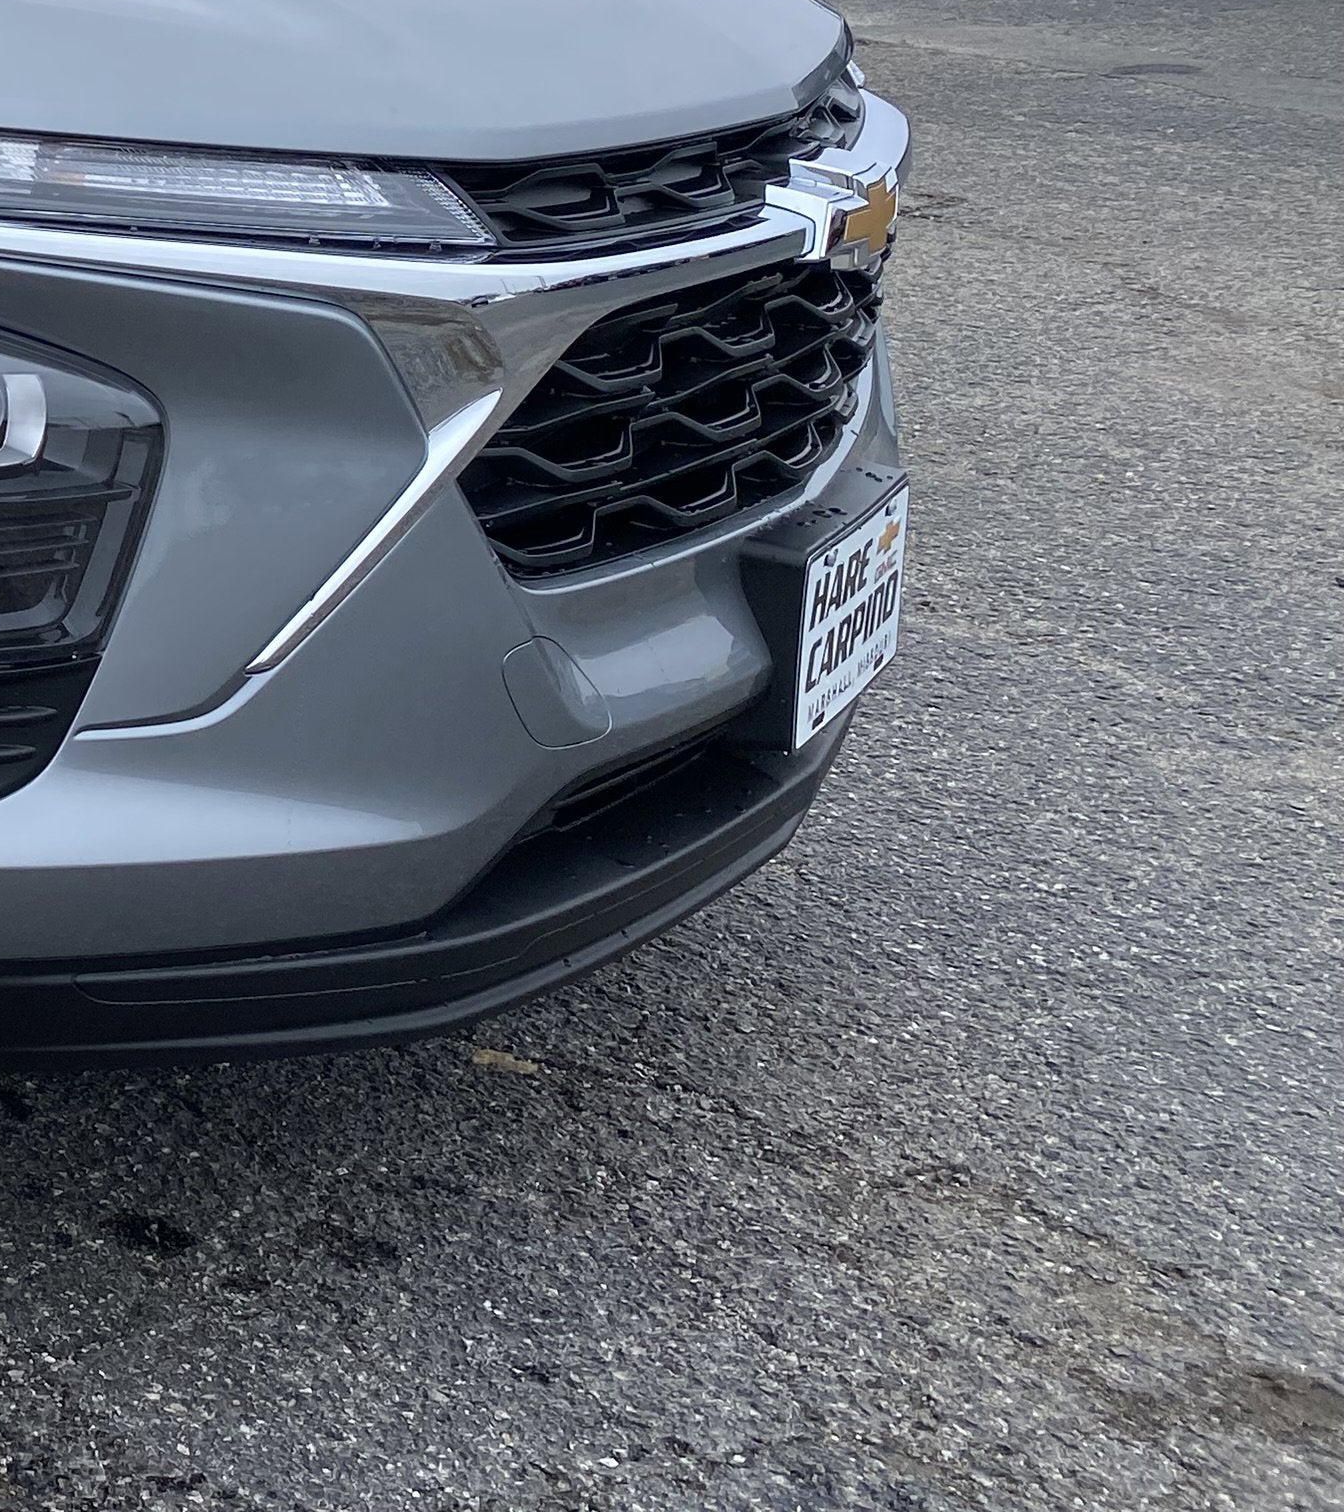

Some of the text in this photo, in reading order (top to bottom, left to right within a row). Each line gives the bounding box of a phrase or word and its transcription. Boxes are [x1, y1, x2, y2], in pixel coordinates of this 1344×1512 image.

[809, 538, 874, 632] HARE
[874, 550, 898, 584] GMC
[805, 569, 899, 694] CARPINO
